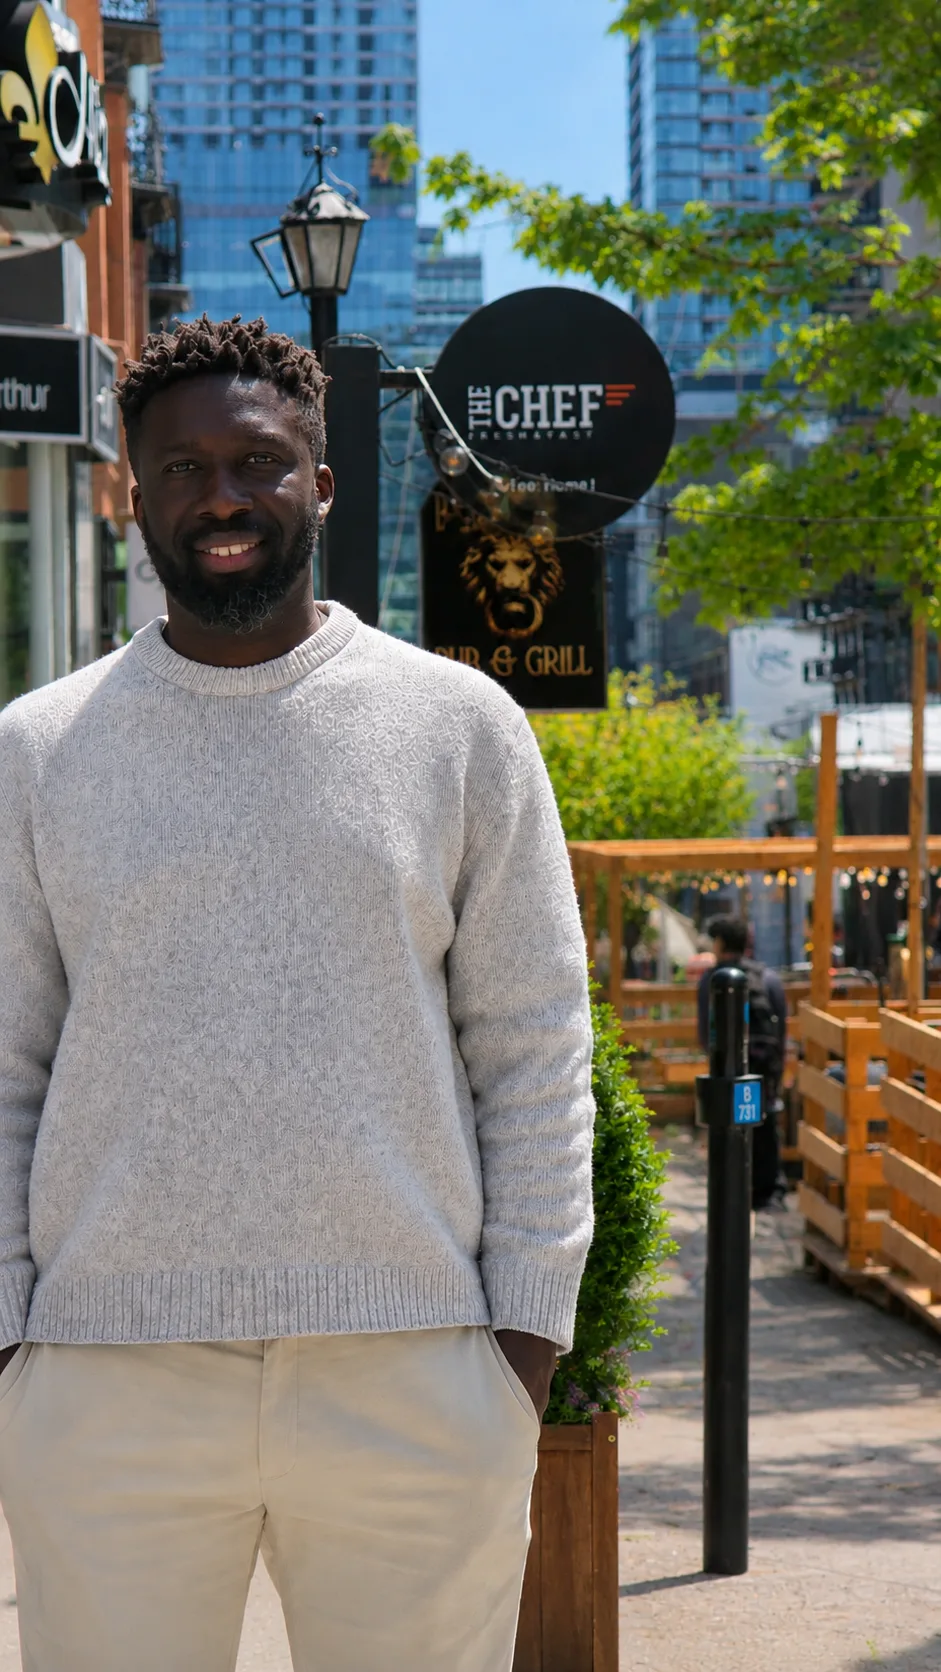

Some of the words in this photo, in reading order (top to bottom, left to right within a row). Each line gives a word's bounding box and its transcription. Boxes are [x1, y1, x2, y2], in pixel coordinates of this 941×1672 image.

[467, 385, 492, 430] THE
[494, 384, 603, 430] CHEF
[489, 645, 518, 677] &
[525, 645, 593, 677] GRILL
[743, 1085, 752, 1103] B
[738, 1104, 756, 1121] 731
